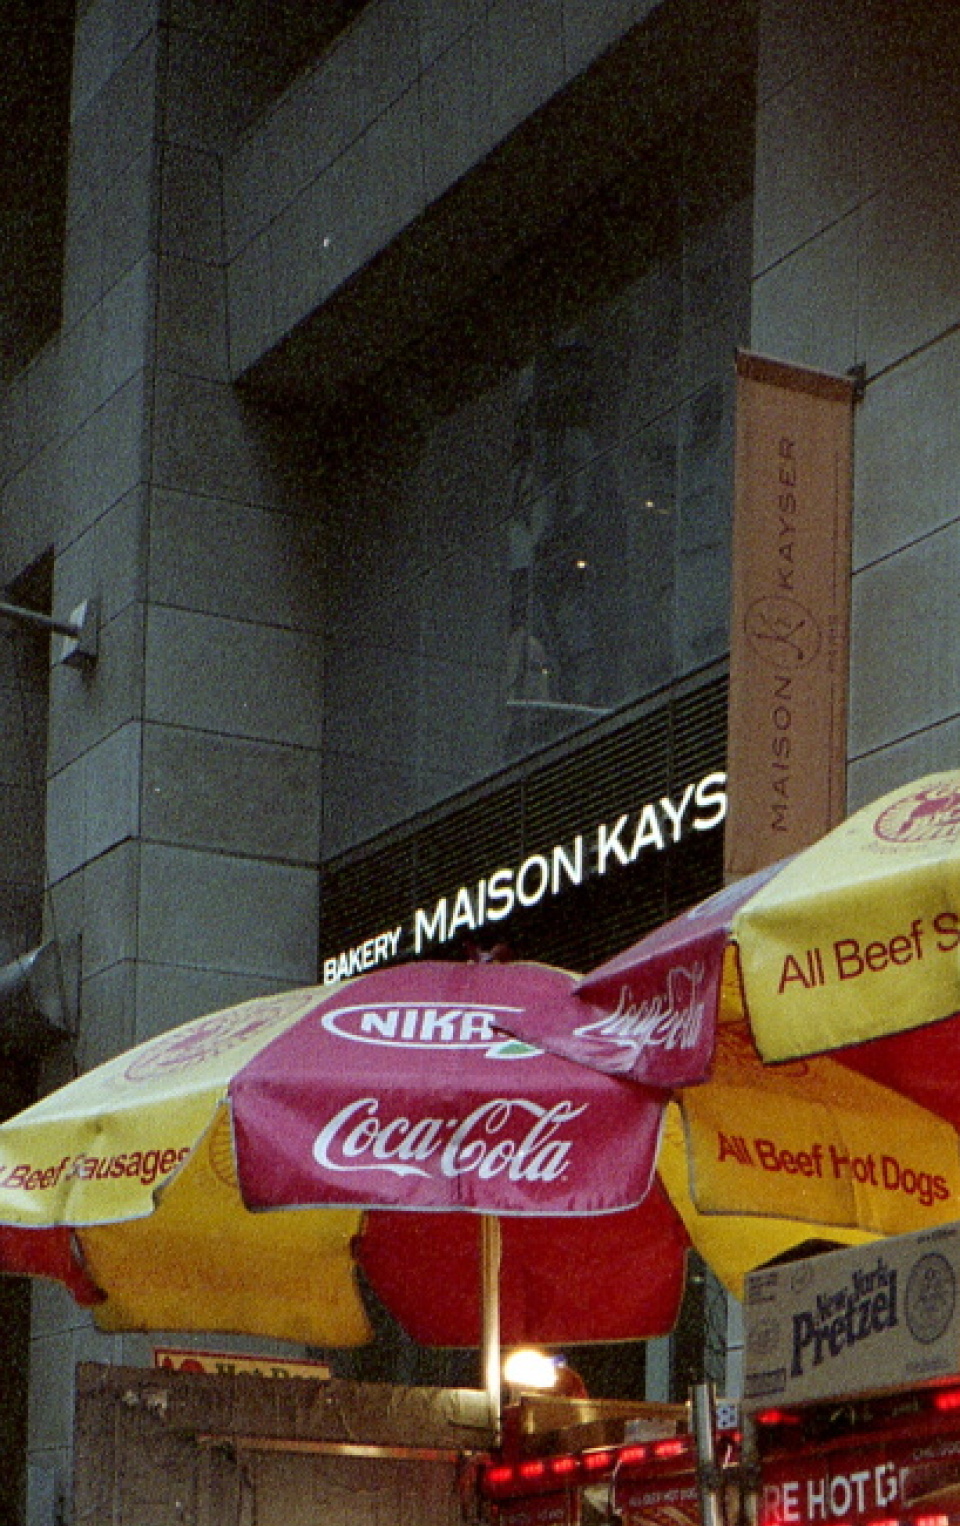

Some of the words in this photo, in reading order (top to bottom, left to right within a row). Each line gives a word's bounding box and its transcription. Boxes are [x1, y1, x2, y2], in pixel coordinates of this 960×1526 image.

[777, 436, 797, 591] KAYSER
[771, 674, 792, 832] MAISON
[323, 926, 403, 987] BAKERY
[413, 834, 583, 954] MAISON
[597, 771, 728, 874] KAYS
[777, 947, 825, 995] All
[832, 918, 924, 982] Beef
[360, 1007, 497, 1041] NIKA
[3, 1156, 71, 1191] Beef
[312, 1097, 590, 1183] Coca-Cola
[717, 1131, 754, 1168] All
[754, 1138, 823, 1179] Beef
[828, 1144, 879, 1186] Hot
[881, 1155, 951, 1207] Dogs
[790, 1270, 899, 1378] Pretzel
[807, 1469, 871, 1521] HOT
